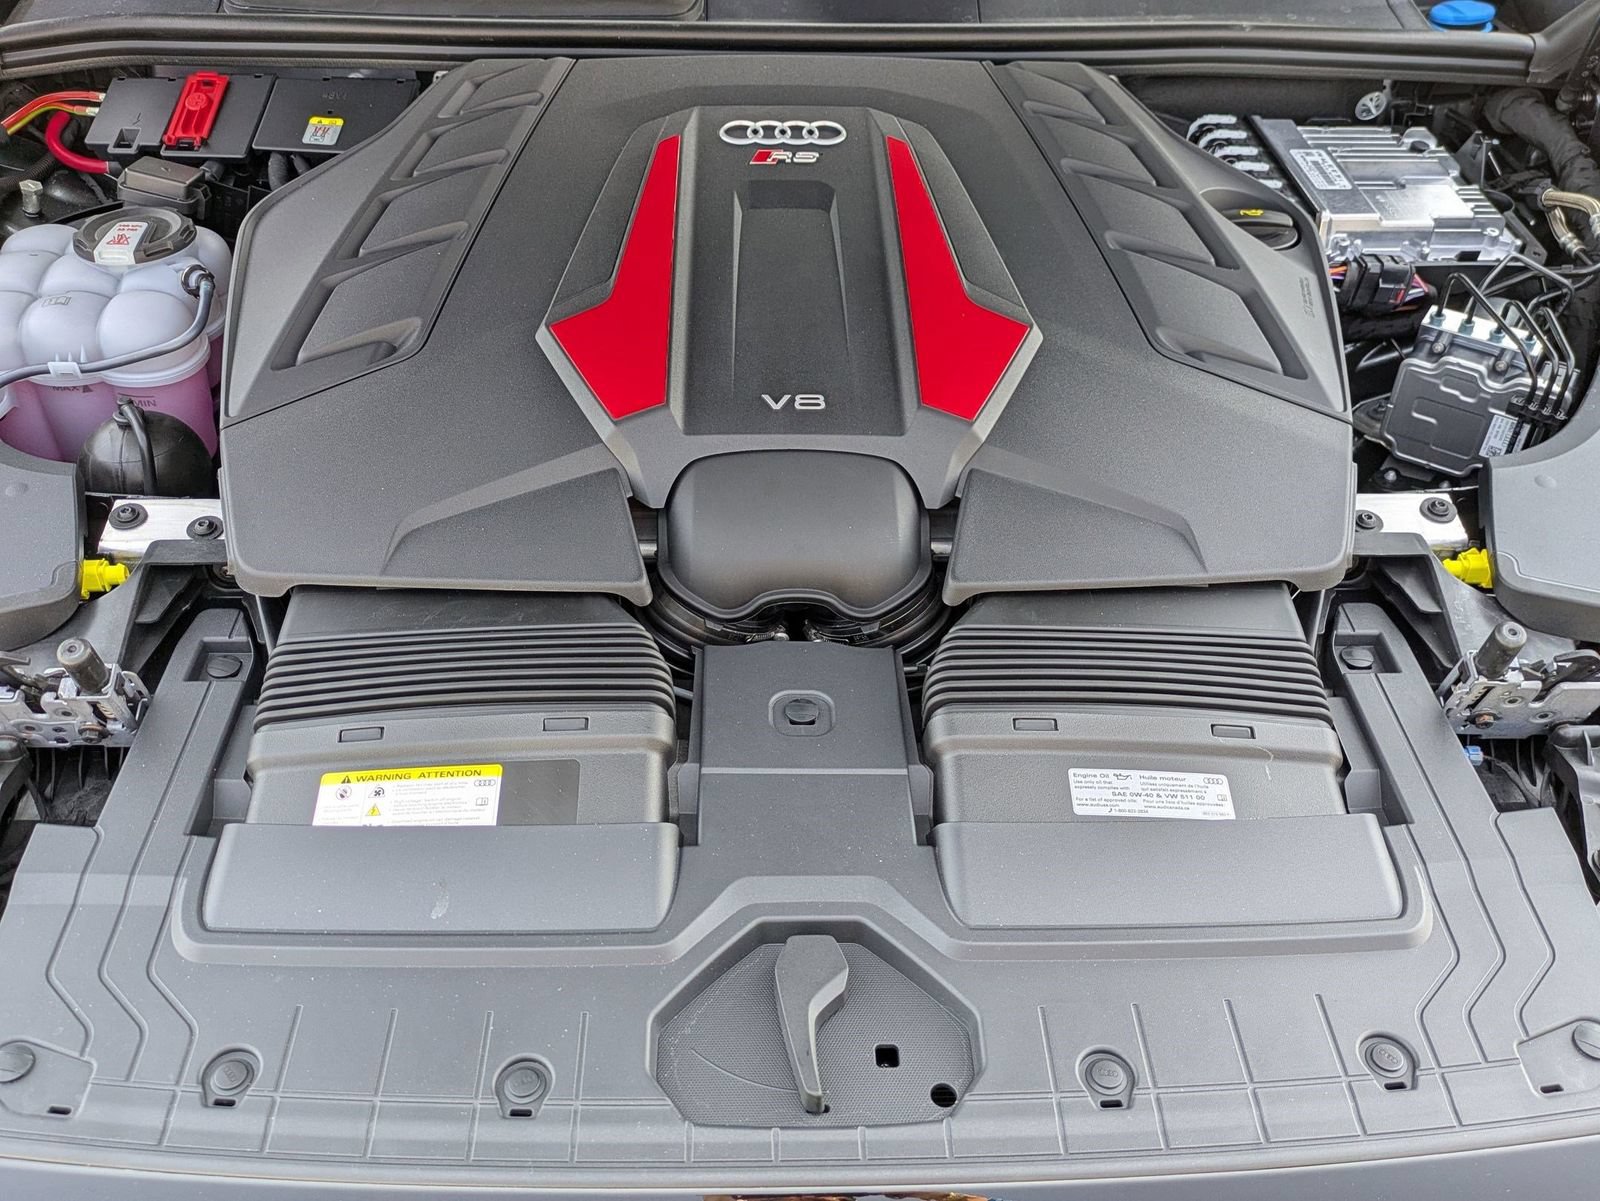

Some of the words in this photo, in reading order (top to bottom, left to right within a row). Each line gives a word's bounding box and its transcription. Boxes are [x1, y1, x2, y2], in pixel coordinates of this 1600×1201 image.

[765, 150, 820, 164] RS
[133, 399, 157, 408] MIN
[761, 394, 826, 410] V8
[356, 772, 412, 782] WARNING
[418, 769, 482, 779] ATTENTION
